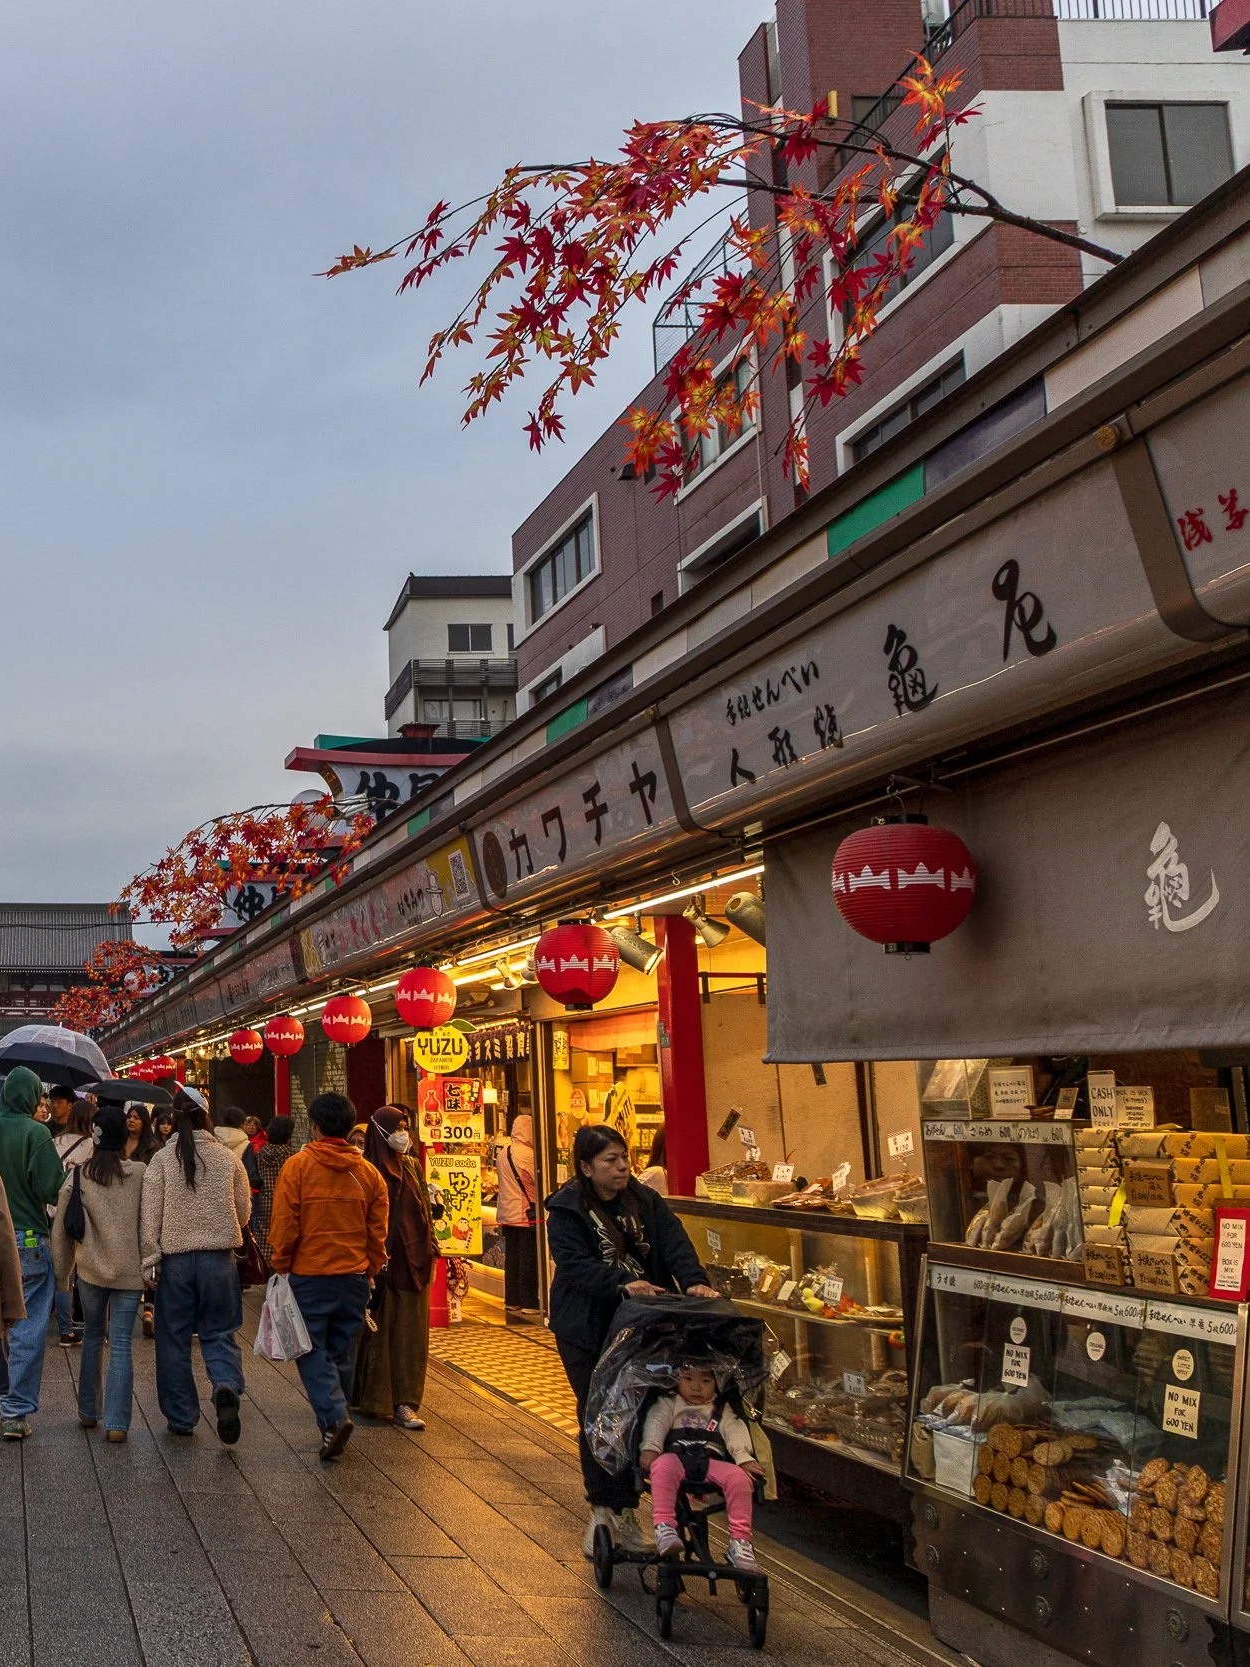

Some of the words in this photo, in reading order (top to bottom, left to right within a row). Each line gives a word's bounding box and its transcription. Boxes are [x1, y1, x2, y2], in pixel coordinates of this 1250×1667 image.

[509, 761, 657, 880] カワチヤ
[417, 1038, 463, 1056] YUZU
[1091, 1087, 1114, 1100] CASH
[1092, 1105, 1114, 1118] ONLY
[999, 1126, 1011, 1138] 600
[1051, 1127, 1064, 1141] 600
[429, 1157, 454, 1168] YUZU
[455, 1158, 477, 1168] soda
[449, 1171, 471, 1212] ゆず
[1005, 1348, 1014, 1357] NO
[1015, 1350, 1028, 1360] MIX
[1011, 1359, 1021, 1367] FOR
[1177, 1362, 1191, 1370] LITTLE
[1004, 1368, 1015, 1377] 600
[1015, 1370, 1027, 1380] YEN
[1168, 1391, 1179, 1402] NO
[1182, 1395, 1197, 1408] MIX
[1174, 1407, 1186, 1417] FOR
[1166, 1417, 1180, 1428] 600
[1181, 1420, 1194, 1432] YEN
